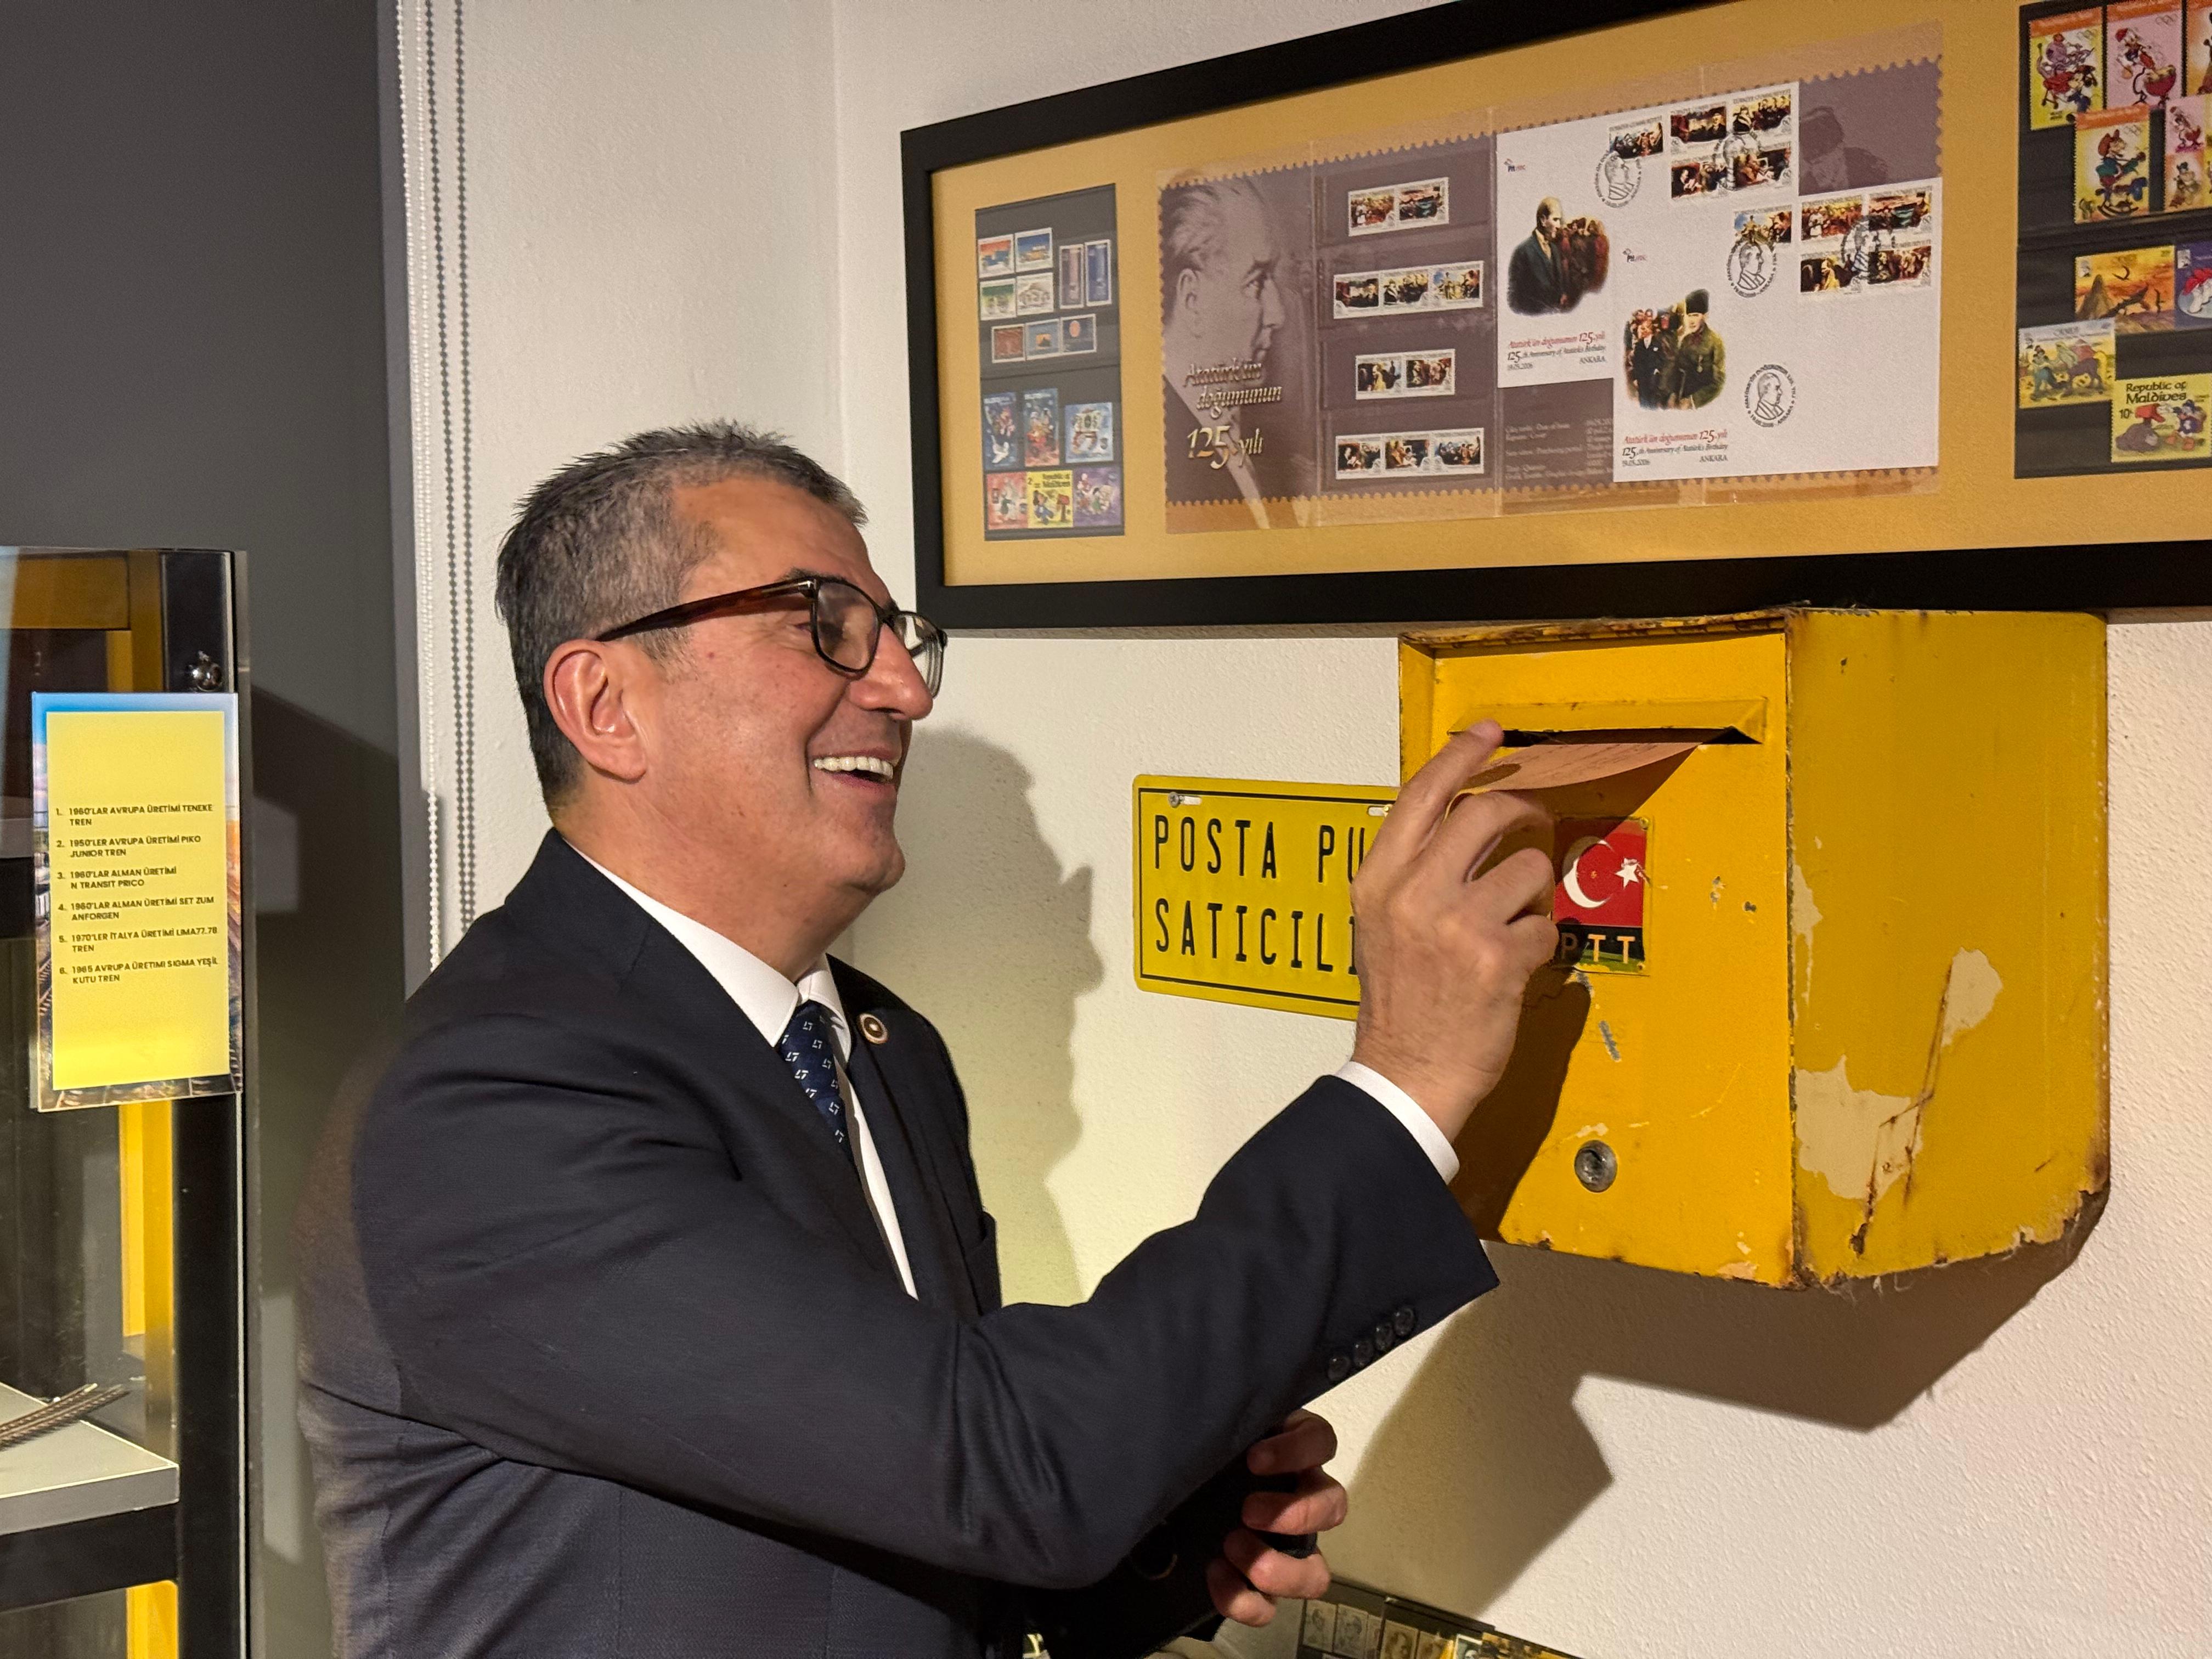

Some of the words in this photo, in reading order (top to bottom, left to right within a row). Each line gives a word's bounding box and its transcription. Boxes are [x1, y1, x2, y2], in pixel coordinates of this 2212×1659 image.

[2126, 383, 2171, 393] Republic
[2175, 381, 2187, 391] of
[2126, 392, 2187, 404] Maldives
[110, 806, 145, 815] AVRUPA
[109, 838, 144, 846] AVRUPA
[1154, 815, 1277, 879] POSTA
[1318, 825, 1365, 884] PU
[111, 869, 142, 877] ALMAN
[80, 881, 115, 889] TRANSIT
[112, 900, 142, 909] ALMAN
[1155, 898, 1358, 975] SATICILI
[1561, 932, 1636, 964] PTT
[95, 963, 131, 973] AVRUPA
[167, 959, 194, 968] SIGMA
[73, 975, 96, 984] KUTU
